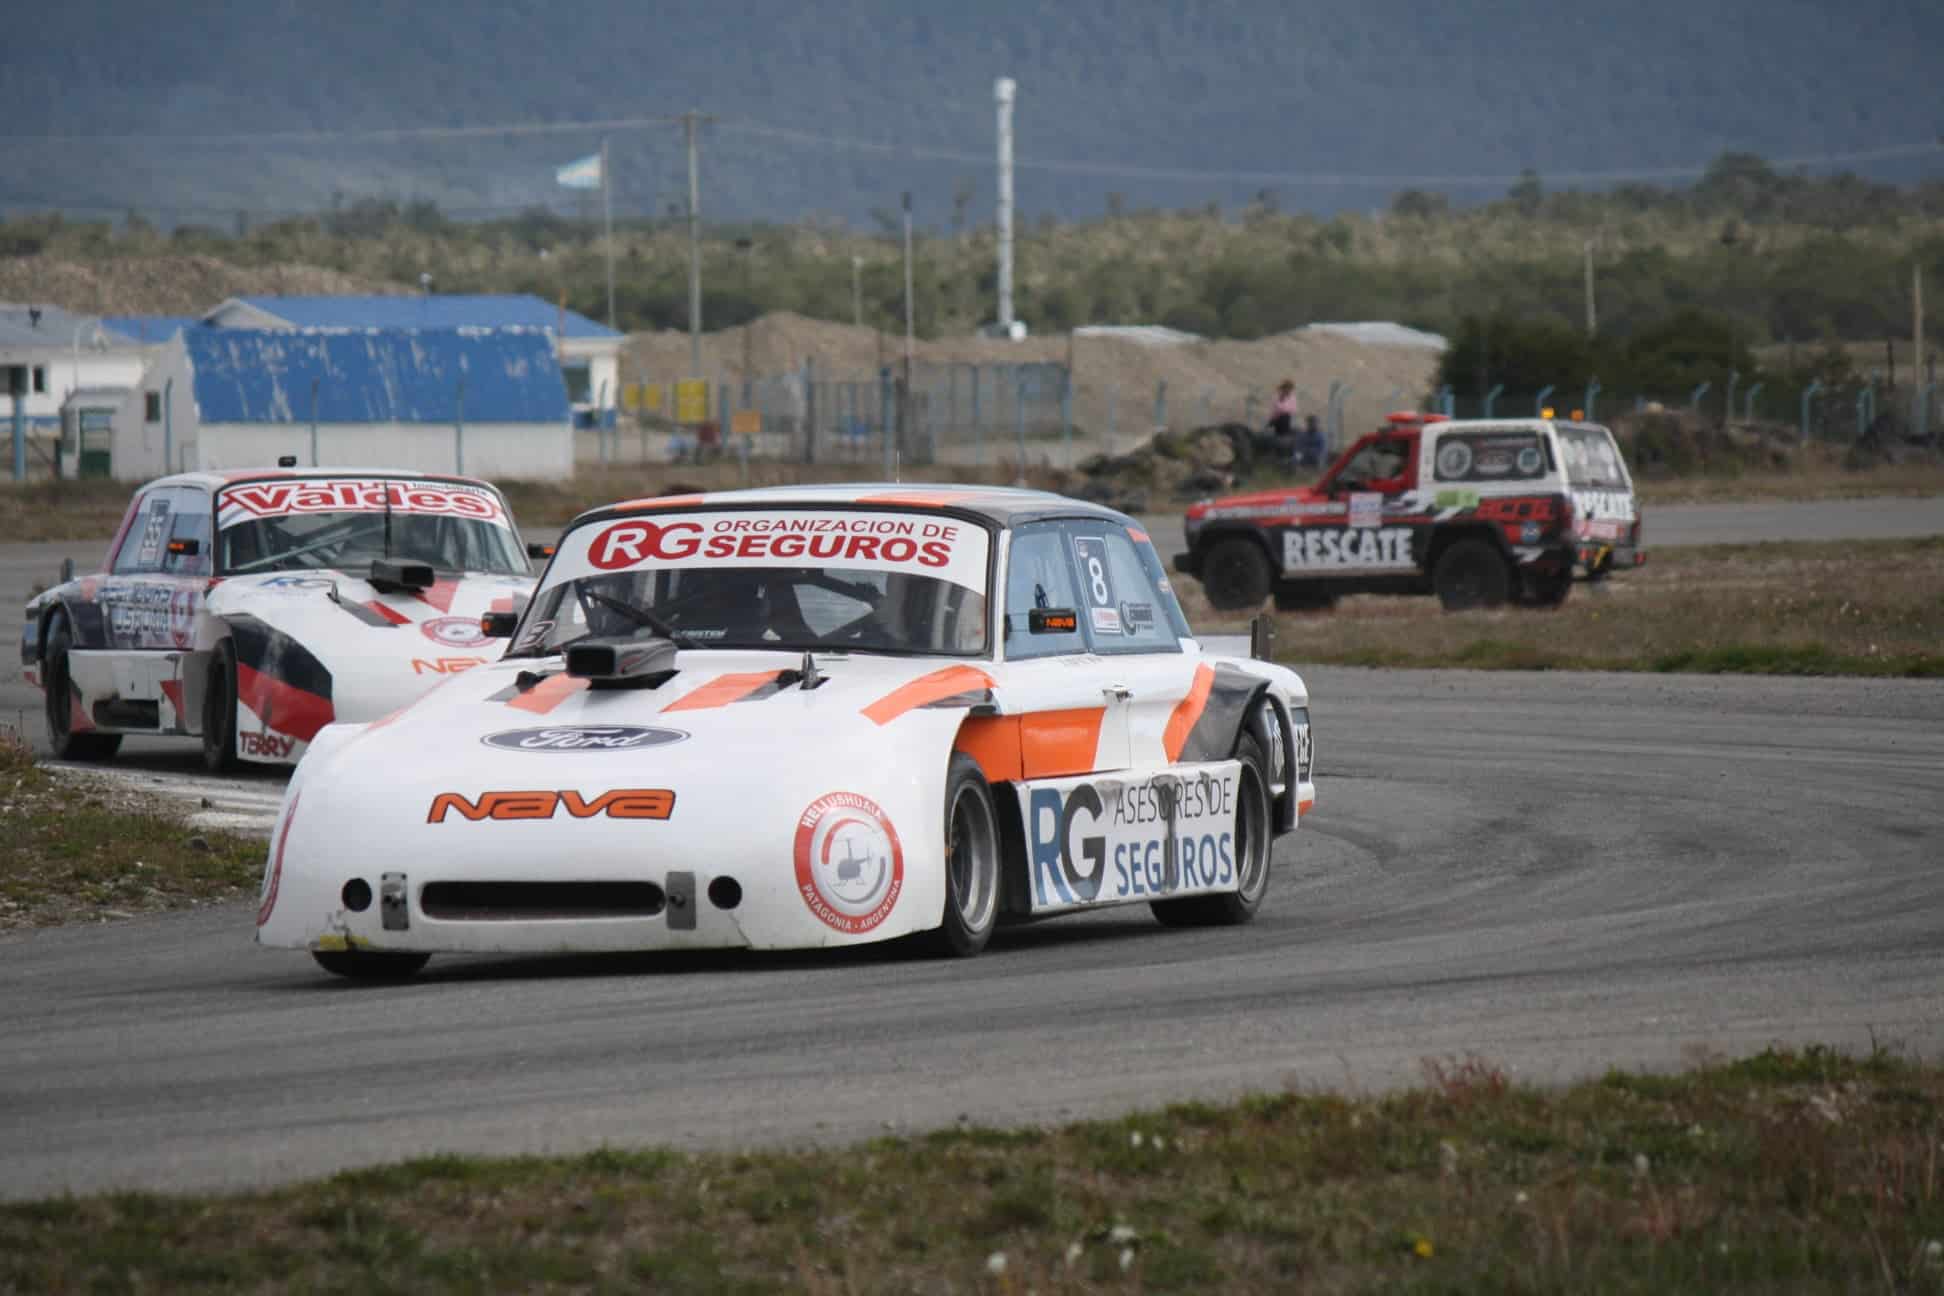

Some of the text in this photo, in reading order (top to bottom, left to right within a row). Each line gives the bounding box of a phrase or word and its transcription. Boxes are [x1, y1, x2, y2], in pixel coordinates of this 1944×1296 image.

[228, 482, 498, 519] Valdes
[589, 521, 705, 569] RG
[713, 519, 959, 542] ORGANIZACION DE
[1282, 528, 1415, 568] RESCATE
[703, 534, 952, 568] SEGUROS
[1088, 556, 1108, 605] 8
[520, 728, 650, 748] Ford
[1208, 777, 1232, 816] DE
[1030, 783, 1106, 906] RG
[1114, 832, 1232, 897] SEGUROS
[803, 883, 852, 929] PATAGONIA
